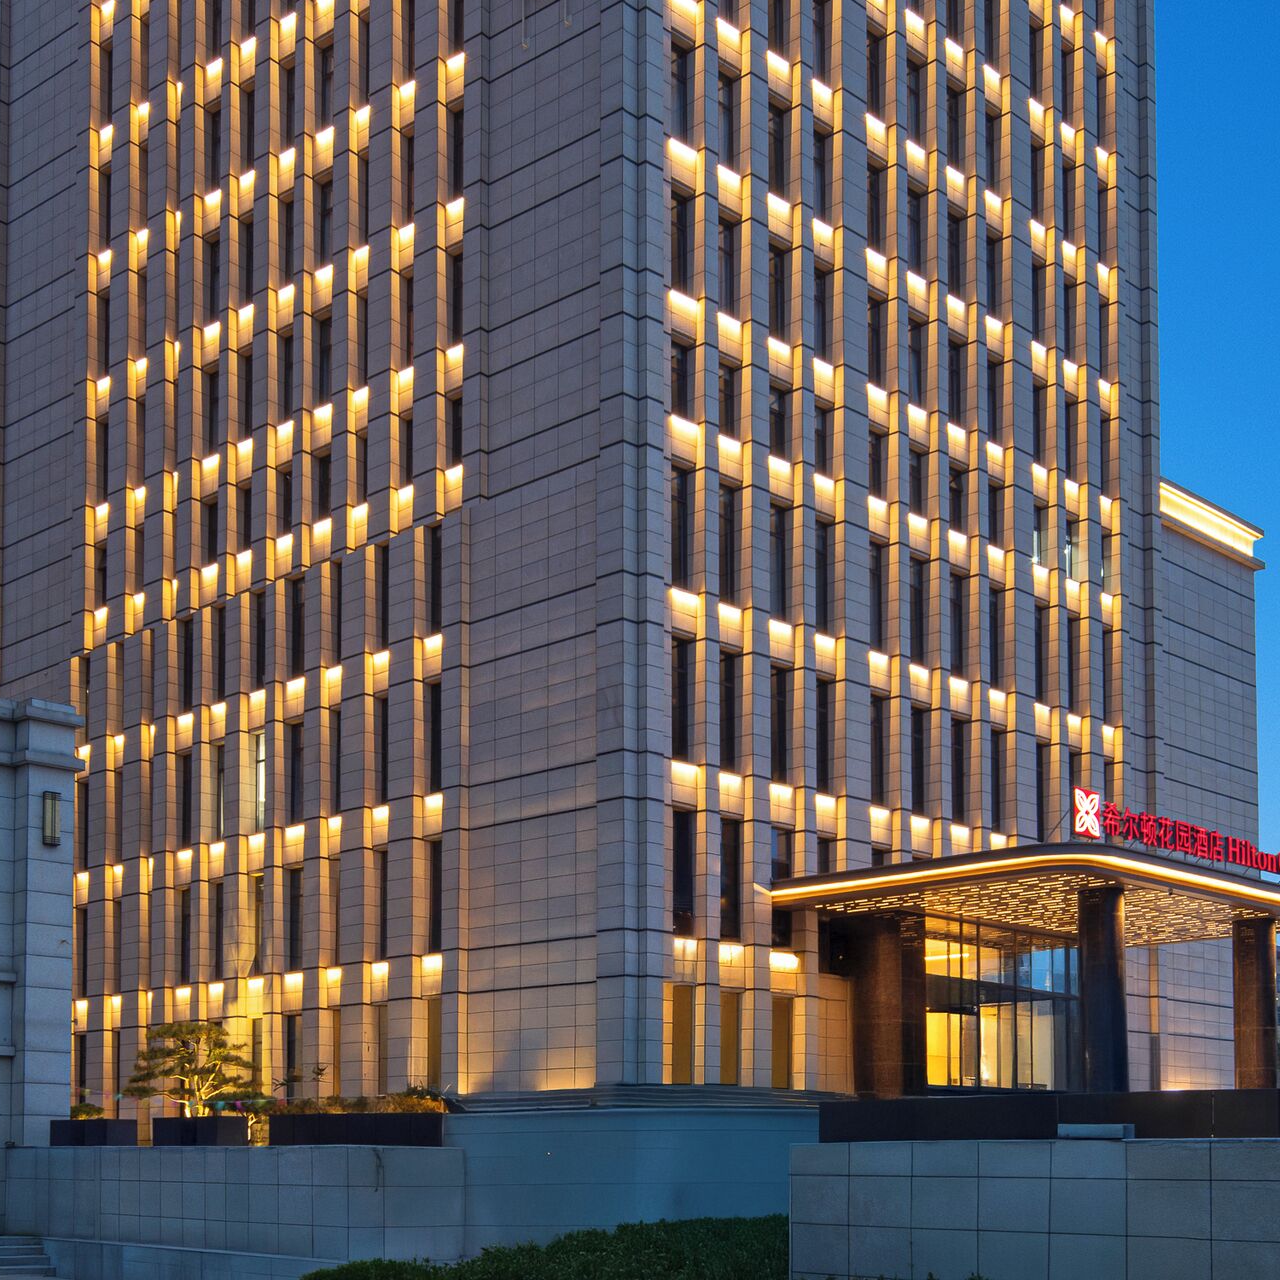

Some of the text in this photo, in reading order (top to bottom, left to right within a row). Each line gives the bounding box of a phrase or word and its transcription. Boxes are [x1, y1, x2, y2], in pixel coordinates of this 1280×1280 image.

[1102, 801, 1224, 862] 希尔顿花园酒店
[1227, 836, 1277, 873] Hilton
